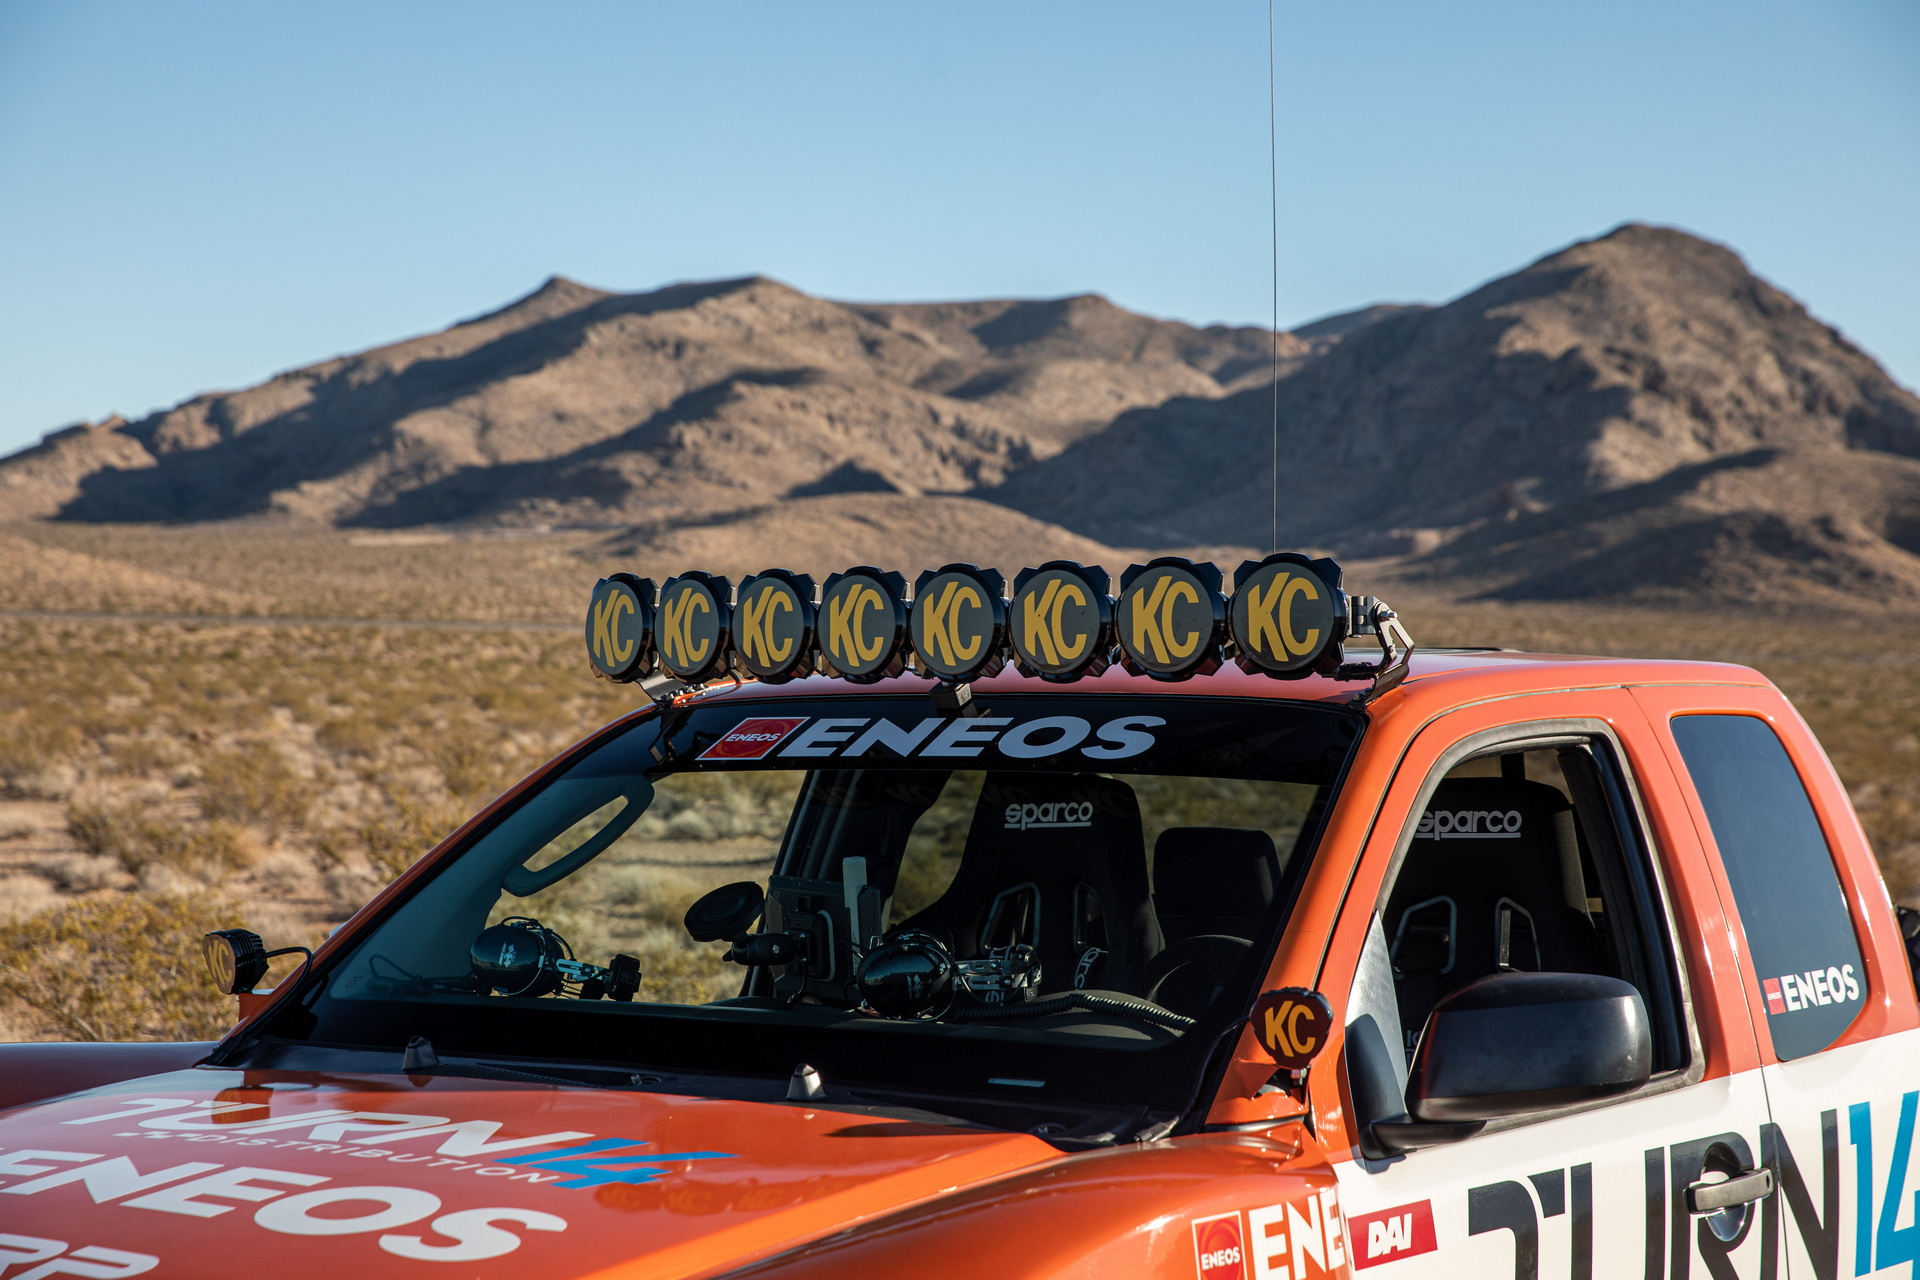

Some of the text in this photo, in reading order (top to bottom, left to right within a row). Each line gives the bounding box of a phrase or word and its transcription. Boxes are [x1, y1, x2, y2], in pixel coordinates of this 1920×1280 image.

[593, 590, 635, 668] KC
[664, 588, 710, 668] KC
[743, 586, 793, 668] KC
[829, 584, 884, 667] KC
[923, 581, 982, 667] KC
[1024, 579, 1087, 666] KC
[1132, 576, 1199, 664] KC
[1248, 572, 1319, 661] KC
[725, 733, 782, 742] ENEOS
[777, 716, 1167, 759] ENEOS
[1004, 801, 1094, 831] sparco
[1416, 810, 1522, 841] sparco
[208, 940, 233, 985] KC
[1780, 964, 1860, 1012] ENEOS
[1265, 1000, 1316, 1057] KC
[185, 1132, 561, 1184] DISTRIBUTION
[1201, 1246, 1241, 1271] ENEOS
[1367, 1212, 1413, 1259] DAI
